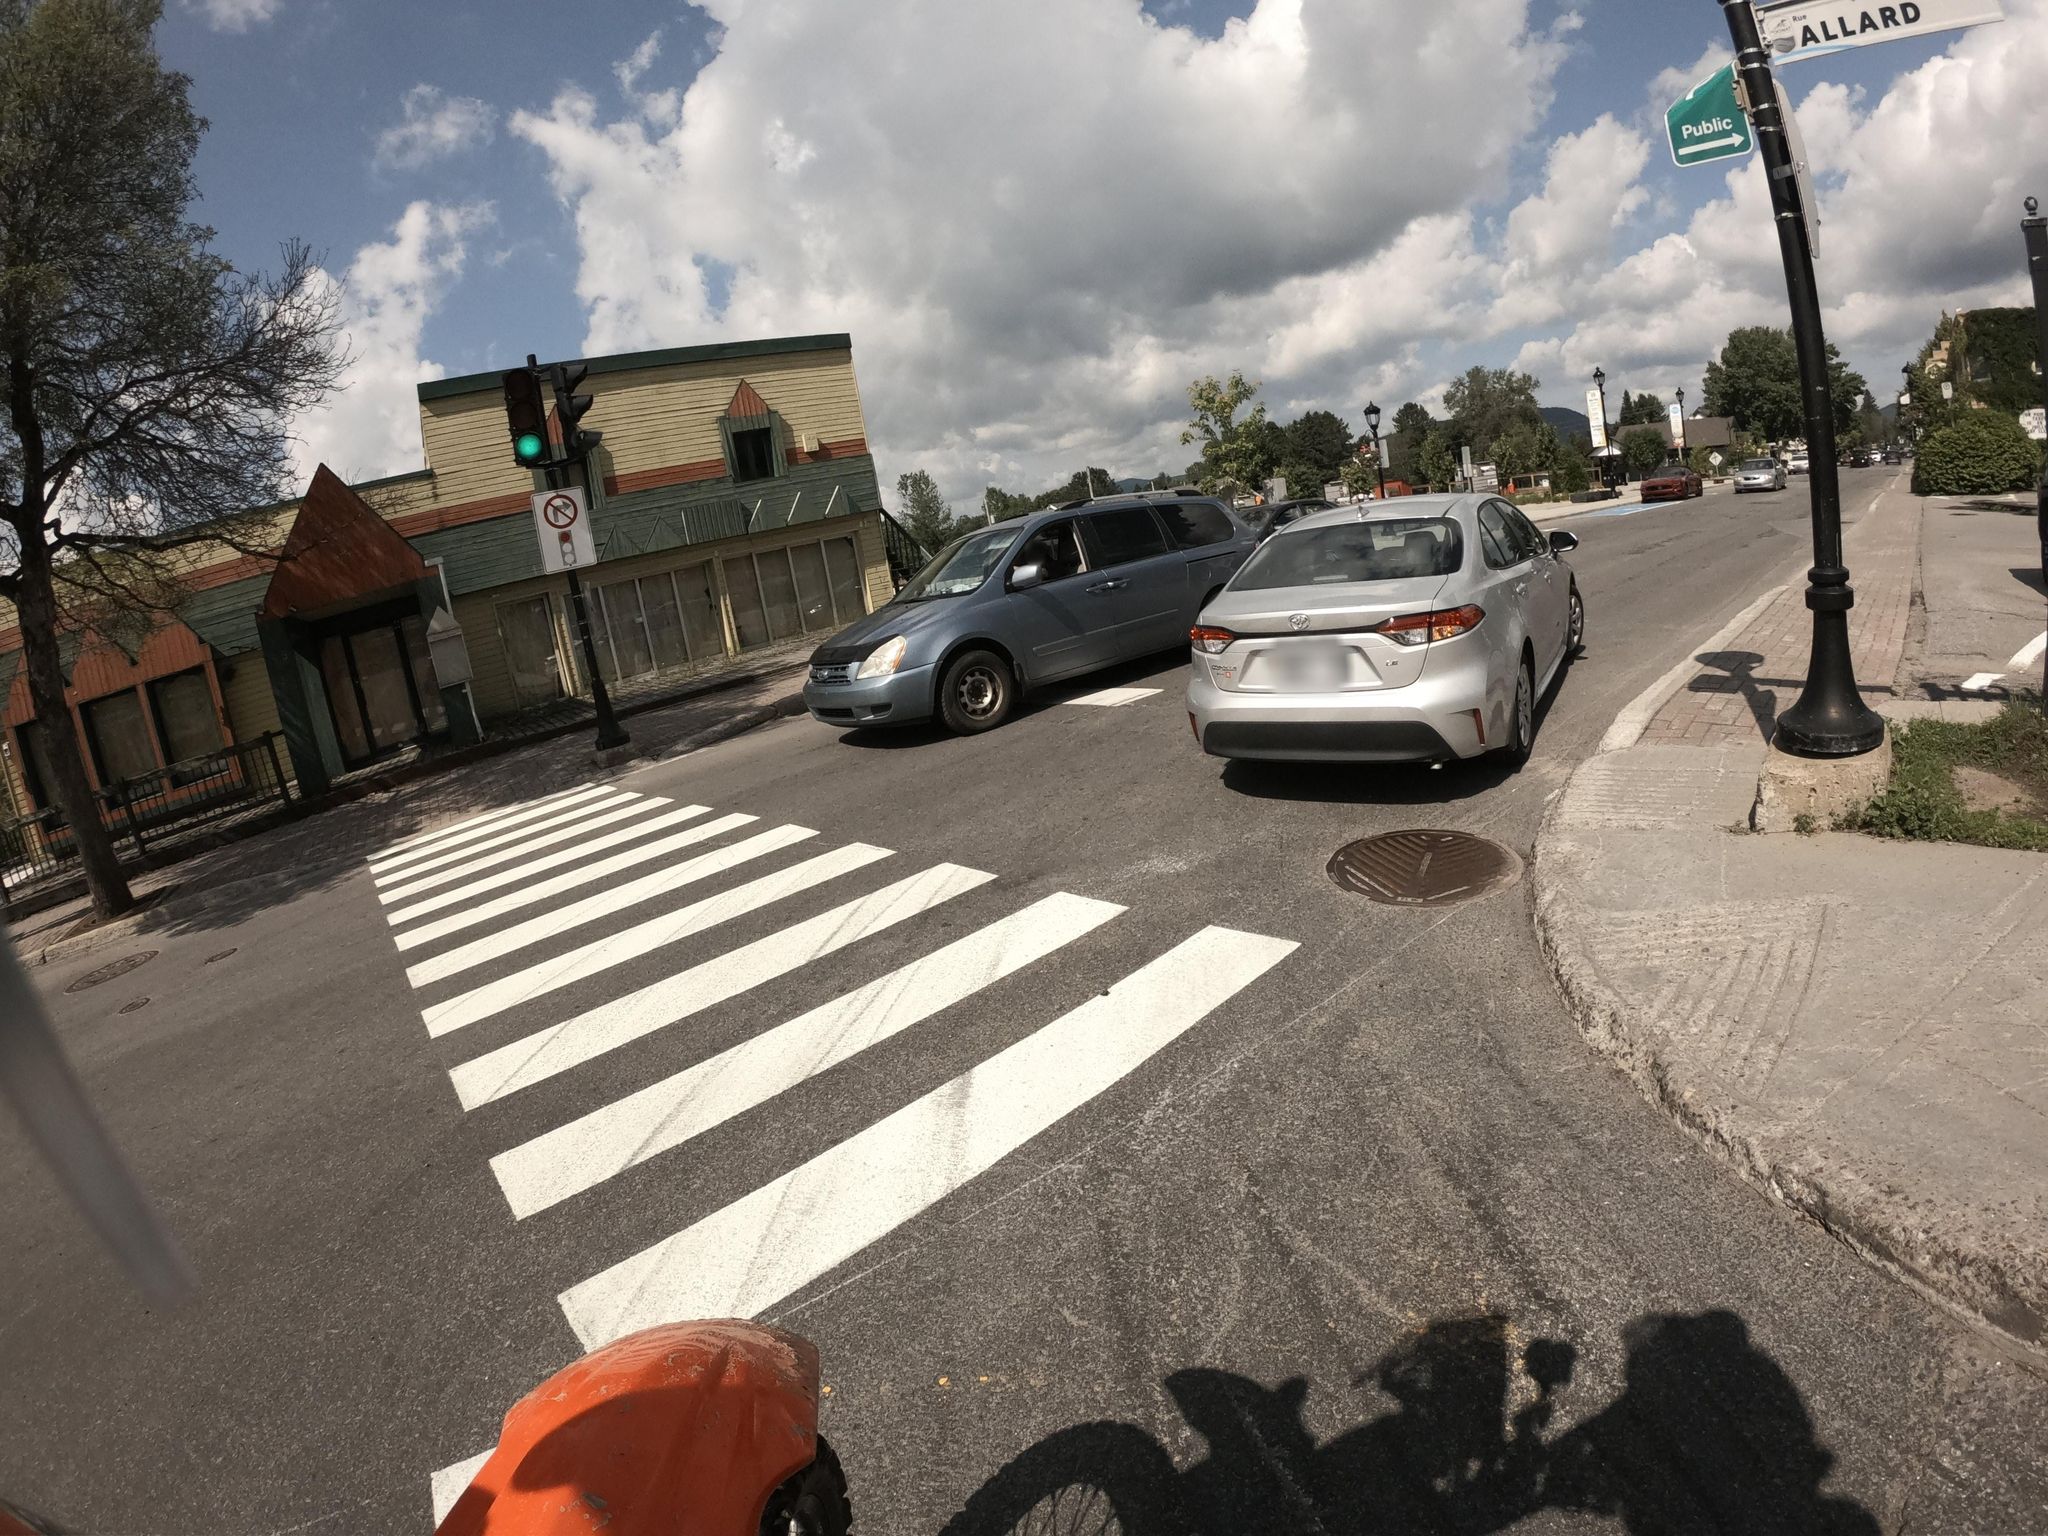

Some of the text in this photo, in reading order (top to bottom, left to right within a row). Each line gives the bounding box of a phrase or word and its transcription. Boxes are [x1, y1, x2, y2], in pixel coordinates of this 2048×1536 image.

[1792, 14, 1807, 22] Rue
[1801, 2, 1921, 47] ALLARD
[1682, 117, 1733, 139] Public
